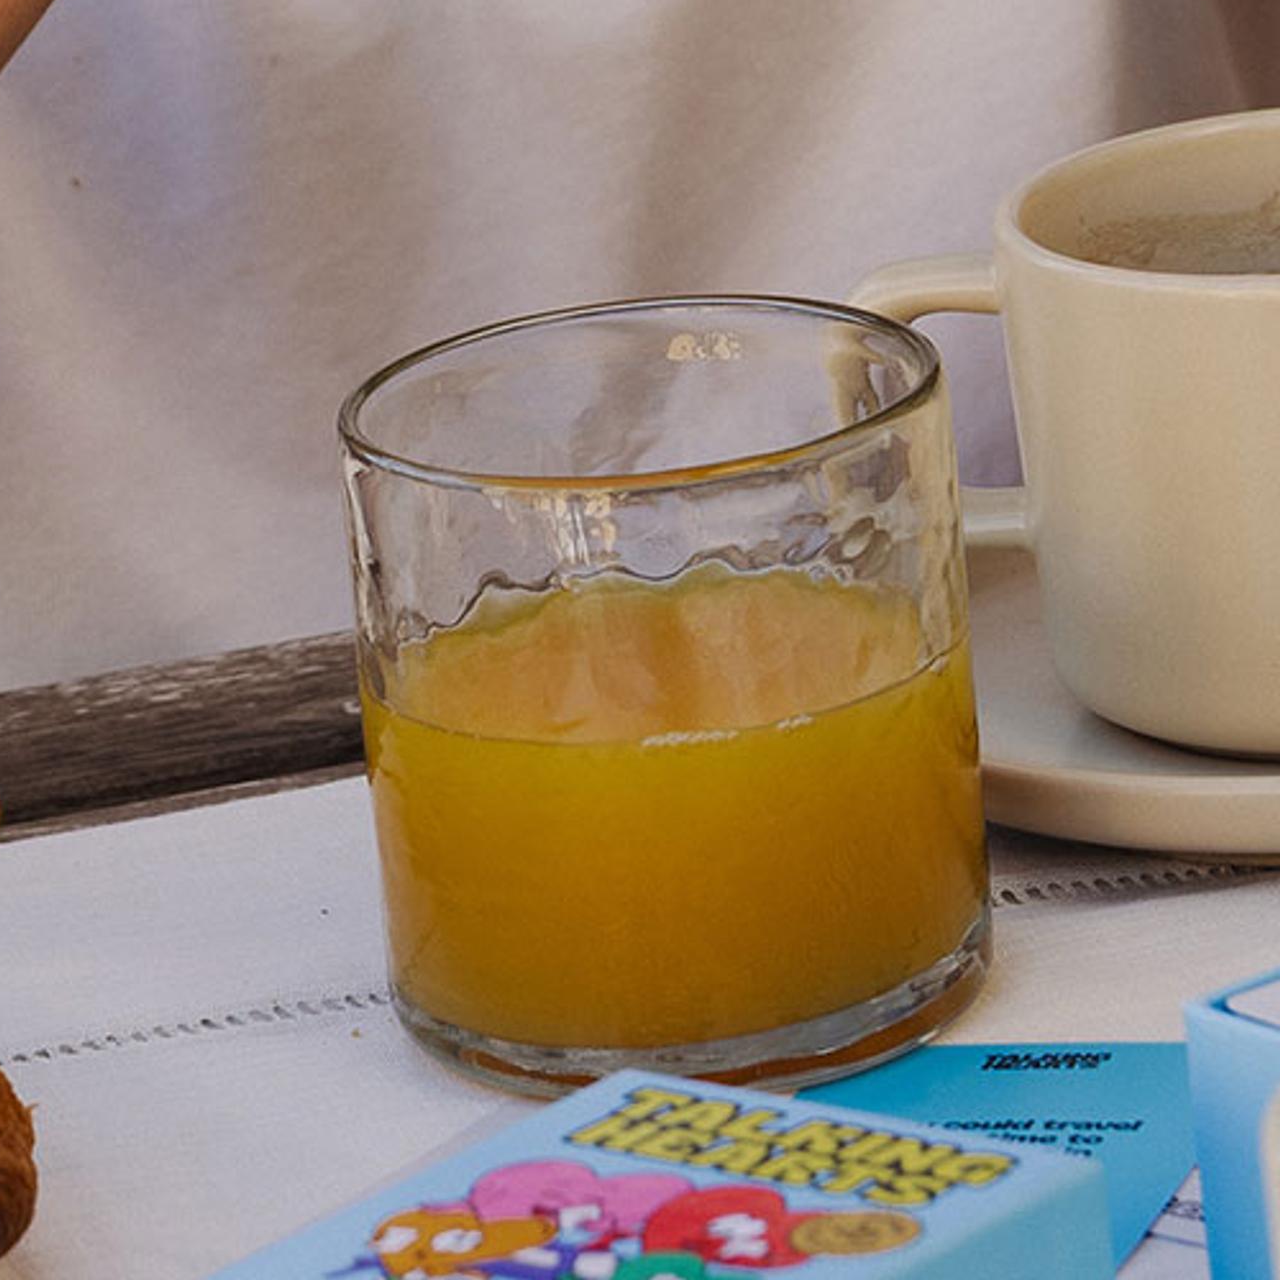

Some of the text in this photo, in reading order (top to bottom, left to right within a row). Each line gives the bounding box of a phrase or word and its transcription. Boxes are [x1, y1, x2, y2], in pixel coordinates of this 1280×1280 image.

[564, 1113, 954, 1210] HEARTS
[625, 1084, 1022, 1188] TALKING
[1043, 1118, 1145, 1132] travel
